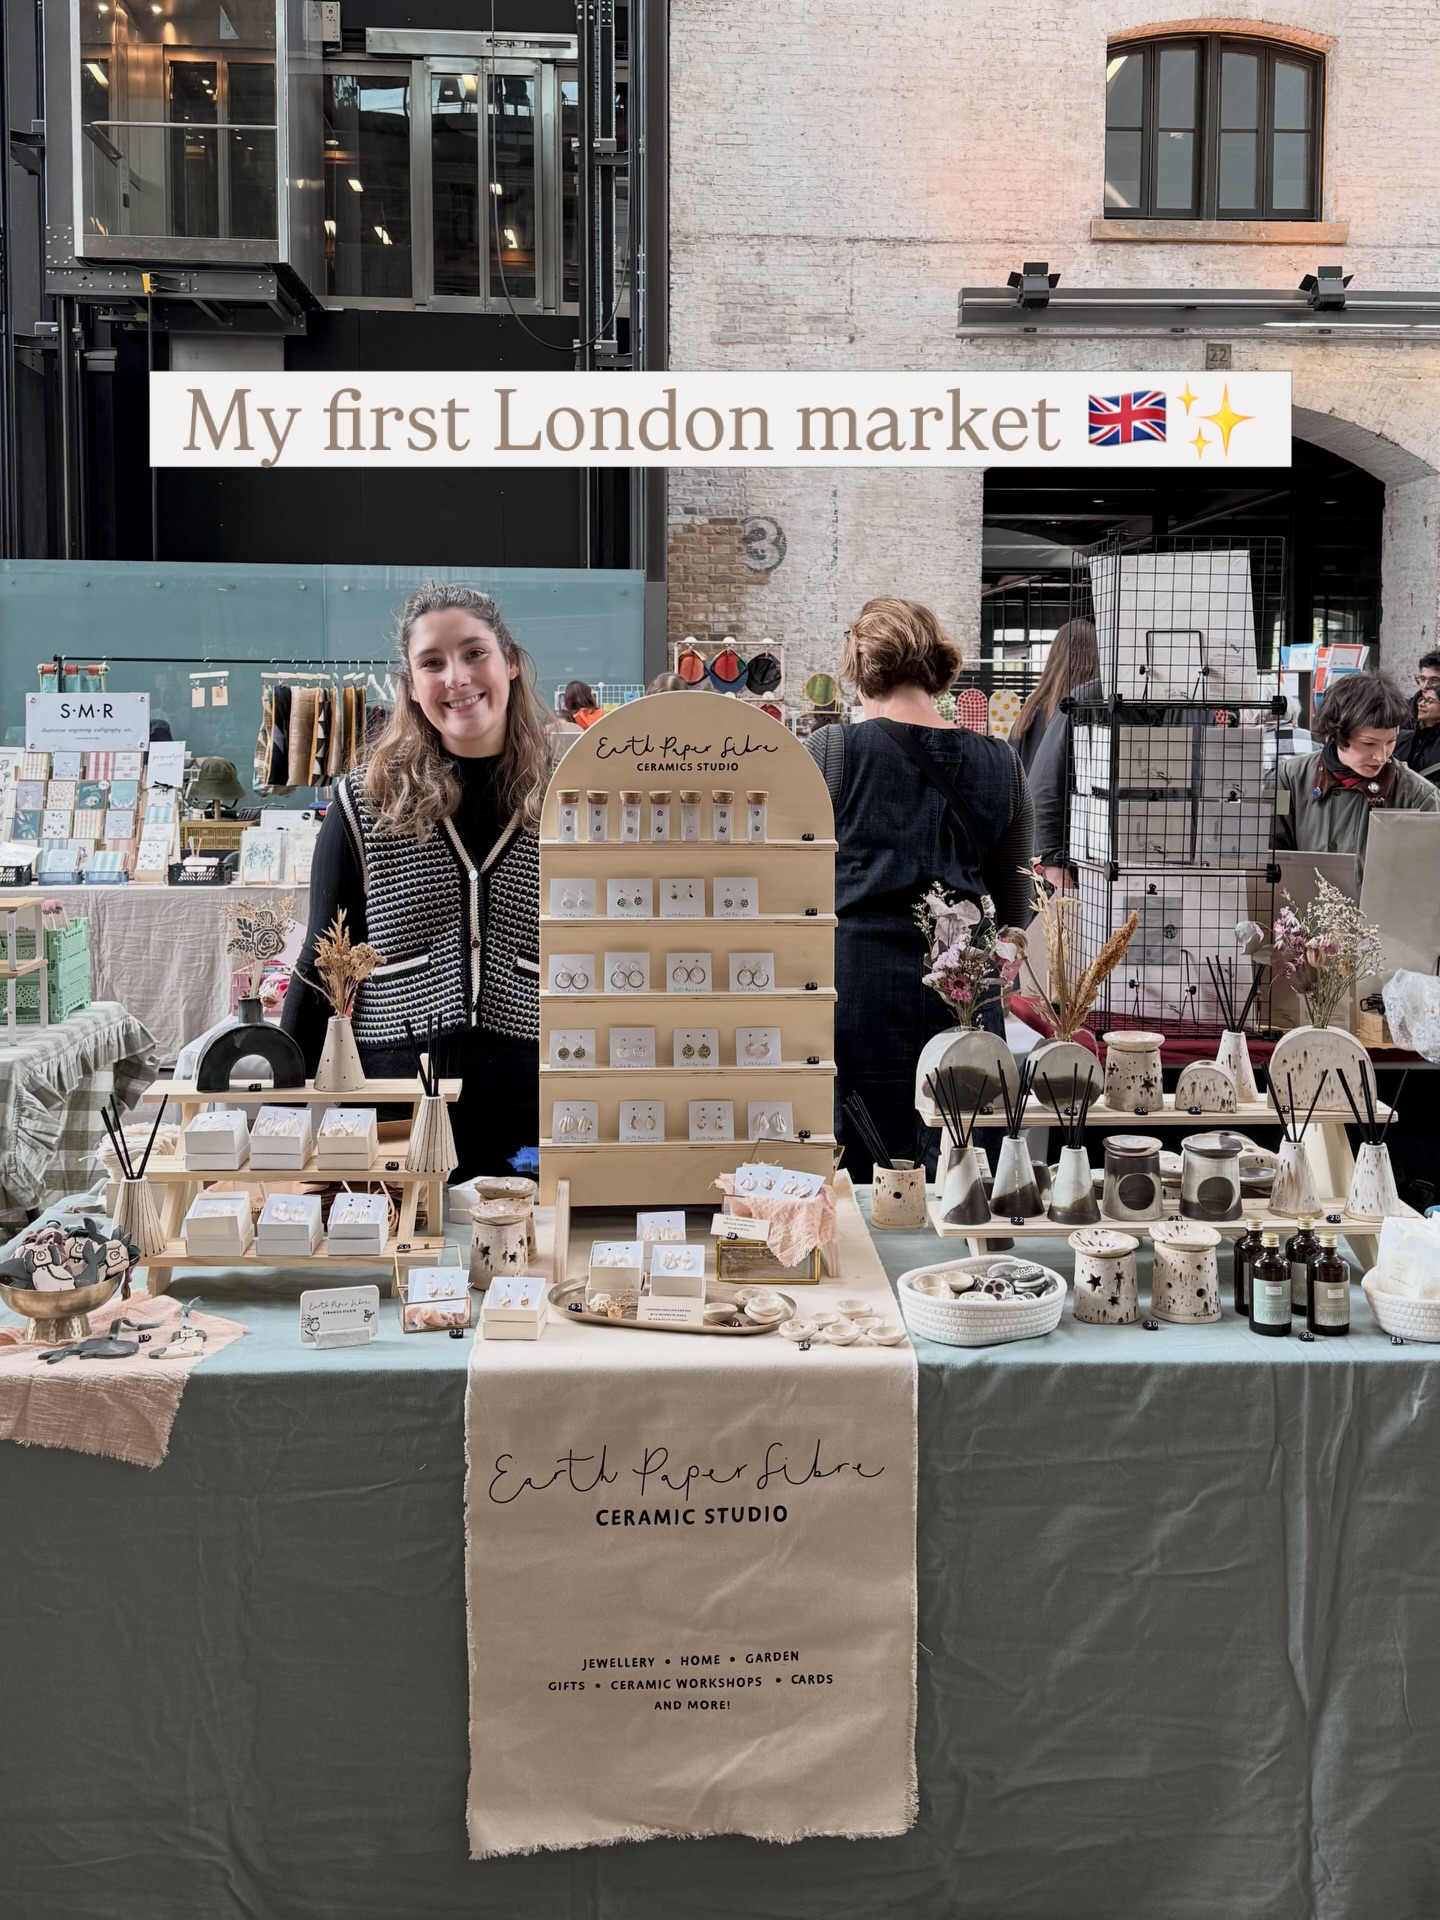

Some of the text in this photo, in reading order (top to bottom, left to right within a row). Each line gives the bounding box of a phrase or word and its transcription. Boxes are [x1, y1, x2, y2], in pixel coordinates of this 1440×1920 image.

[1208, 347, 1229, 362] 22
[595, 734, 655, 760] Earth
[659, 735, 713, 761] Paper
[636, 762, 739, 772] CERAMICS STUDIO
[488, 1443, 619, 1504] Earth
[631, 1446, 749, 1501] Paper
[595, 1504, 789, 1527] CERAMIC STUDIO
[581, 1650, 800, 1671] JEWELLERY HOME GARDEN
[547, 1673, 834, 1691] GIFTS CERAMIC WORKSHOPS CARDS
[653, 1700, 731, 1711] AND MORE!
